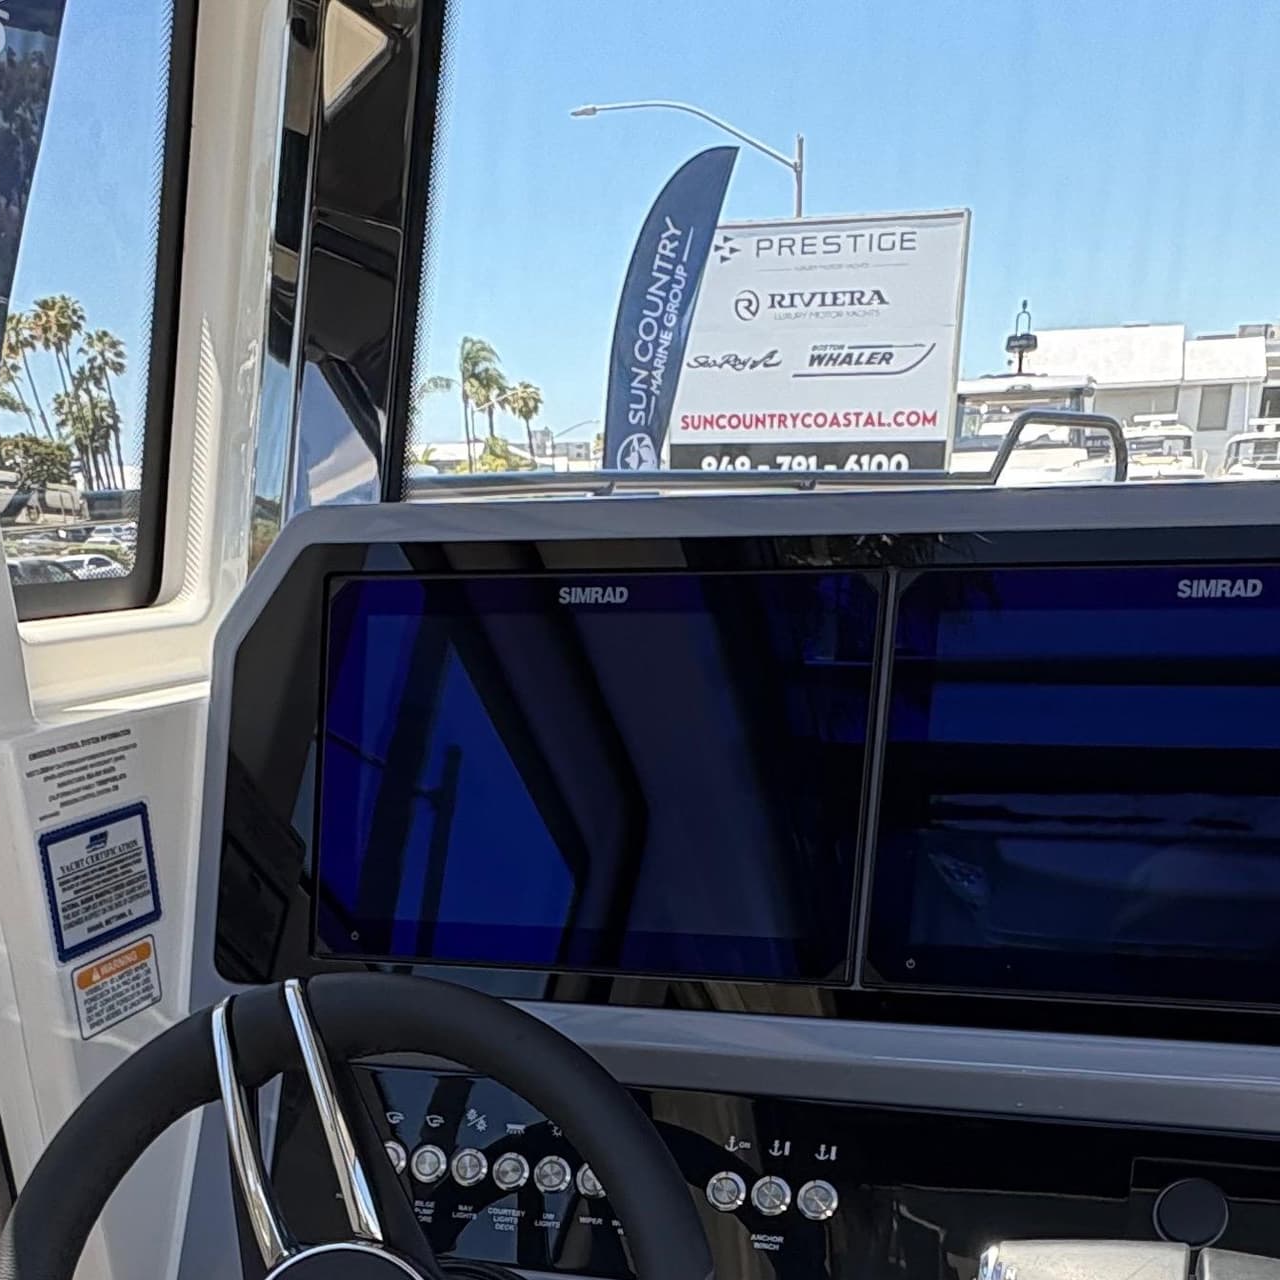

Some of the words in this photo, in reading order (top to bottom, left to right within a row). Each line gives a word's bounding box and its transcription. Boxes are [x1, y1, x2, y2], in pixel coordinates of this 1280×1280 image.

[755, 230, 918, 258] PRESTIGE
[634, 216, 683, 364] COUNTRY
[767, 289, 890, 310] RIVIERA
[649, 327, 673, 395] MARINE
[663, 263, 689, 327] GROUP
[808, 351, 894, 368] WHALER
[628, 367, 649, 427] SUN
[680, 411, 938, 431] SUNCOUNTRYCOASTAL.COM
[559, 586, 629, 604] SIMRAD
[1177, 579, 1263, 598] SIMRAD
[751, 1234, 784, 1244] ANCHOR
